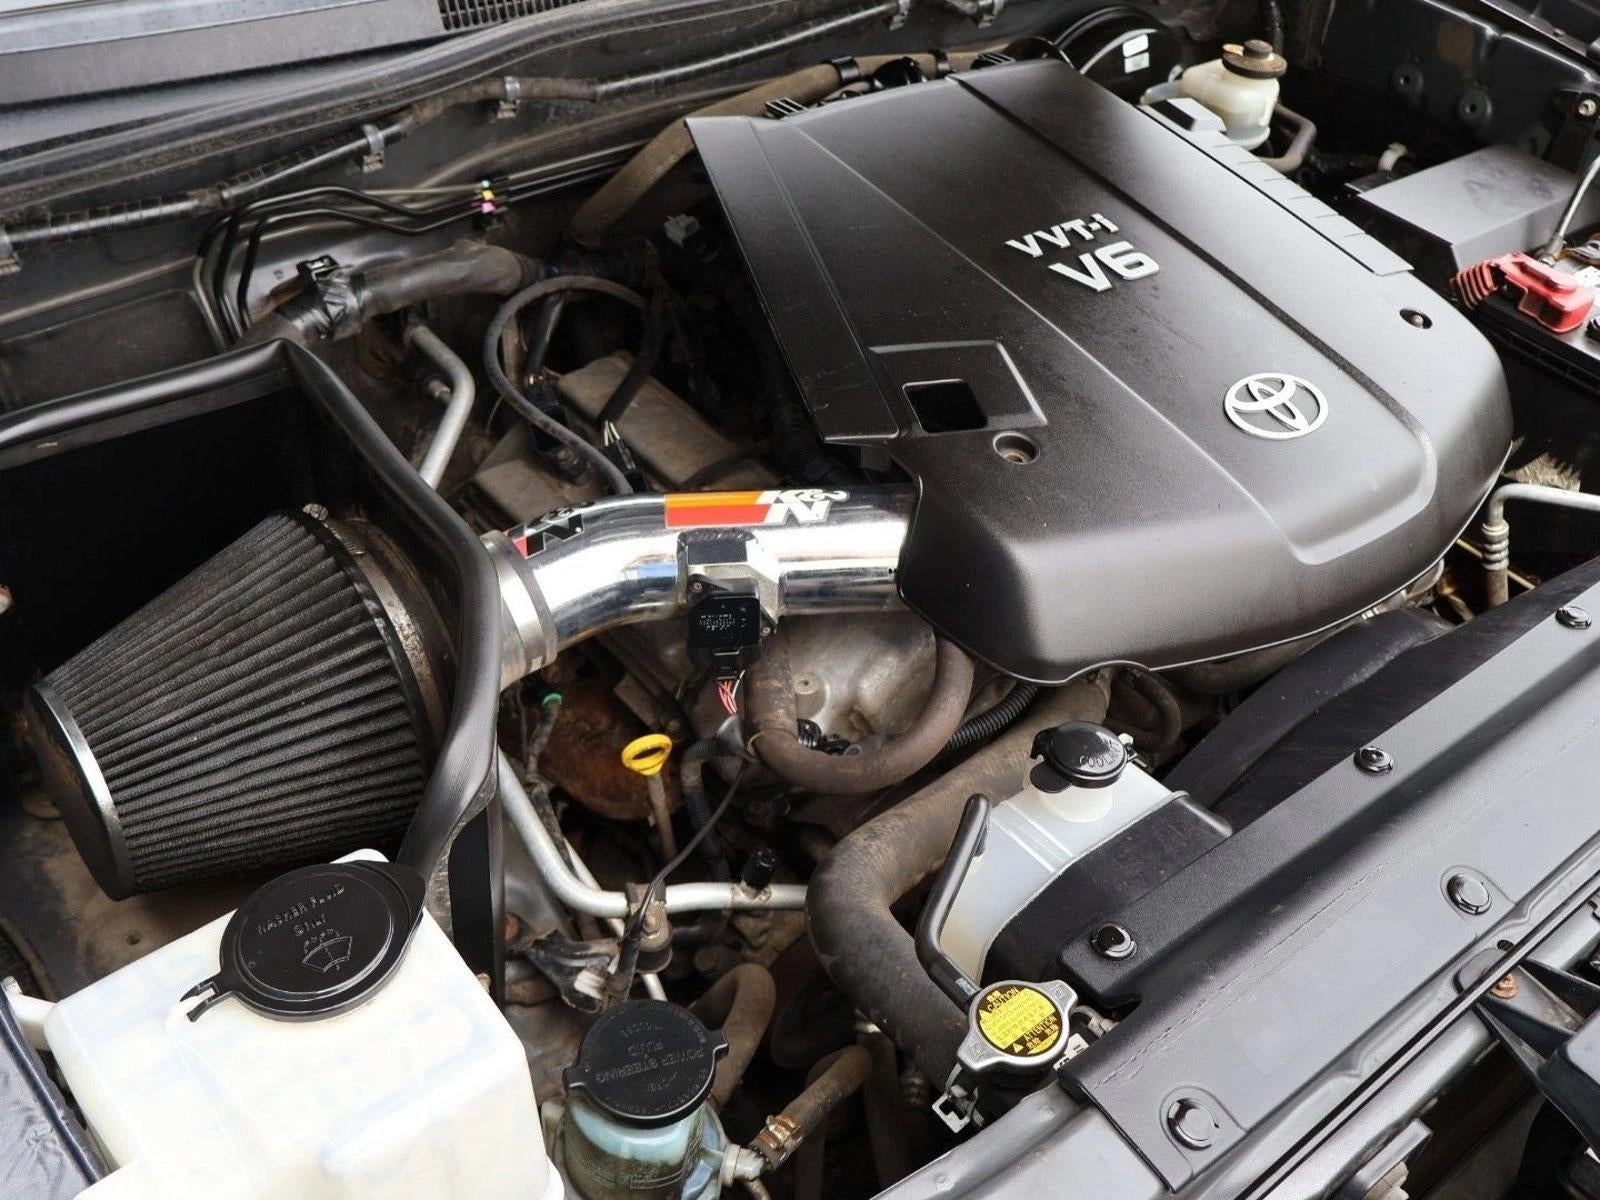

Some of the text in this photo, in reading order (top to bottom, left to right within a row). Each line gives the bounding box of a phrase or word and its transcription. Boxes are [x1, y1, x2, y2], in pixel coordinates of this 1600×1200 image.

[1048, 240, 1160, 292] V6
[755, 489, 850, 527] K&N
[987, 986, 1020, 1012] CAUTION
[1023, 1013, 1058, 1042] ATTENTION
[595, 1057, 659, 1084] STEERING
